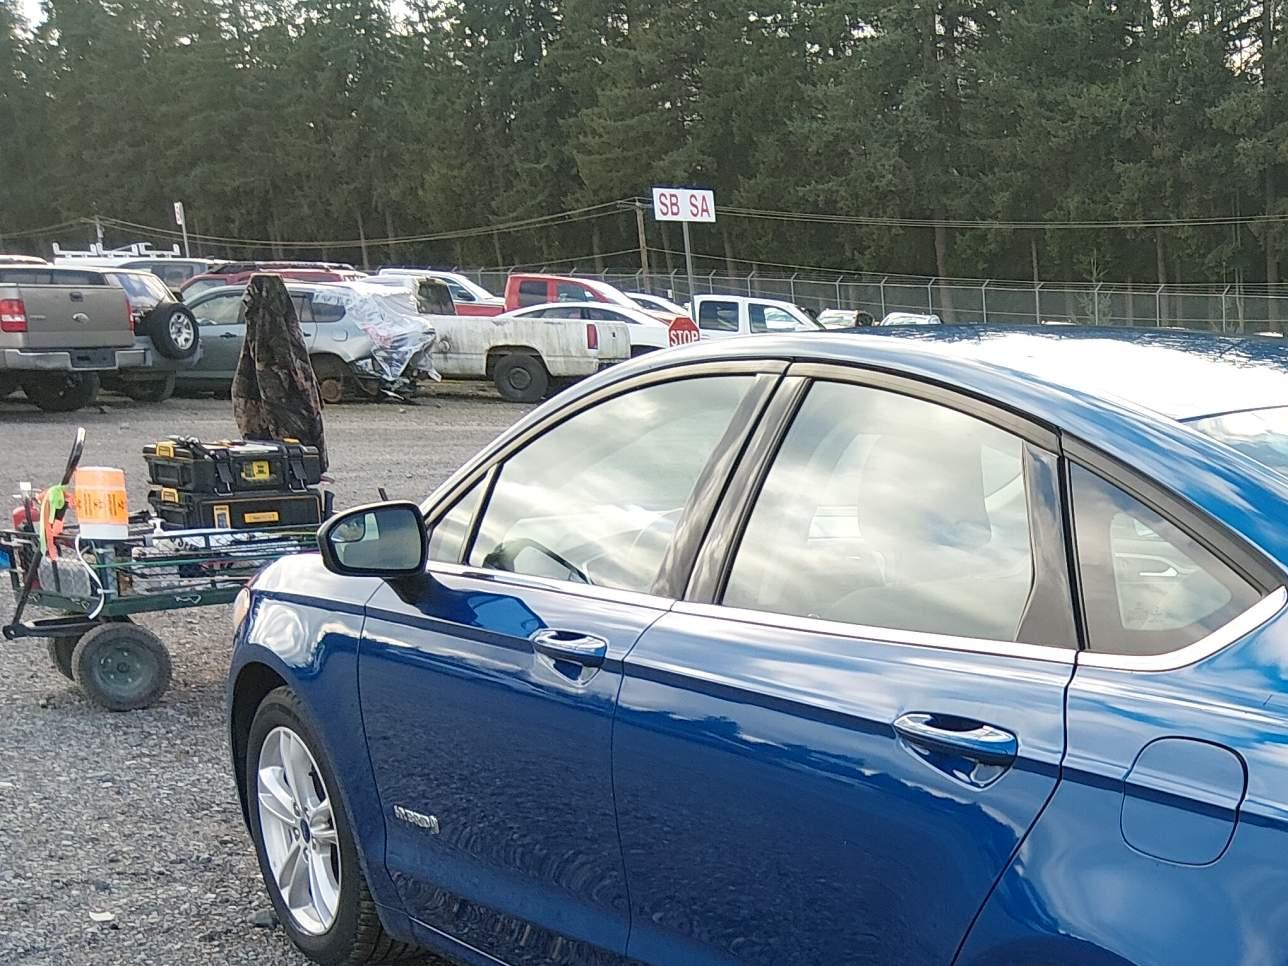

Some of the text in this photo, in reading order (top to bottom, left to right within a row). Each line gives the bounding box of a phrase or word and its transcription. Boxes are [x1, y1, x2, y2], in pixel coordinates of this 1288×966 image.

[659, 193, 711, 217] SB SA
[670, 330, 699, 346] STOP
